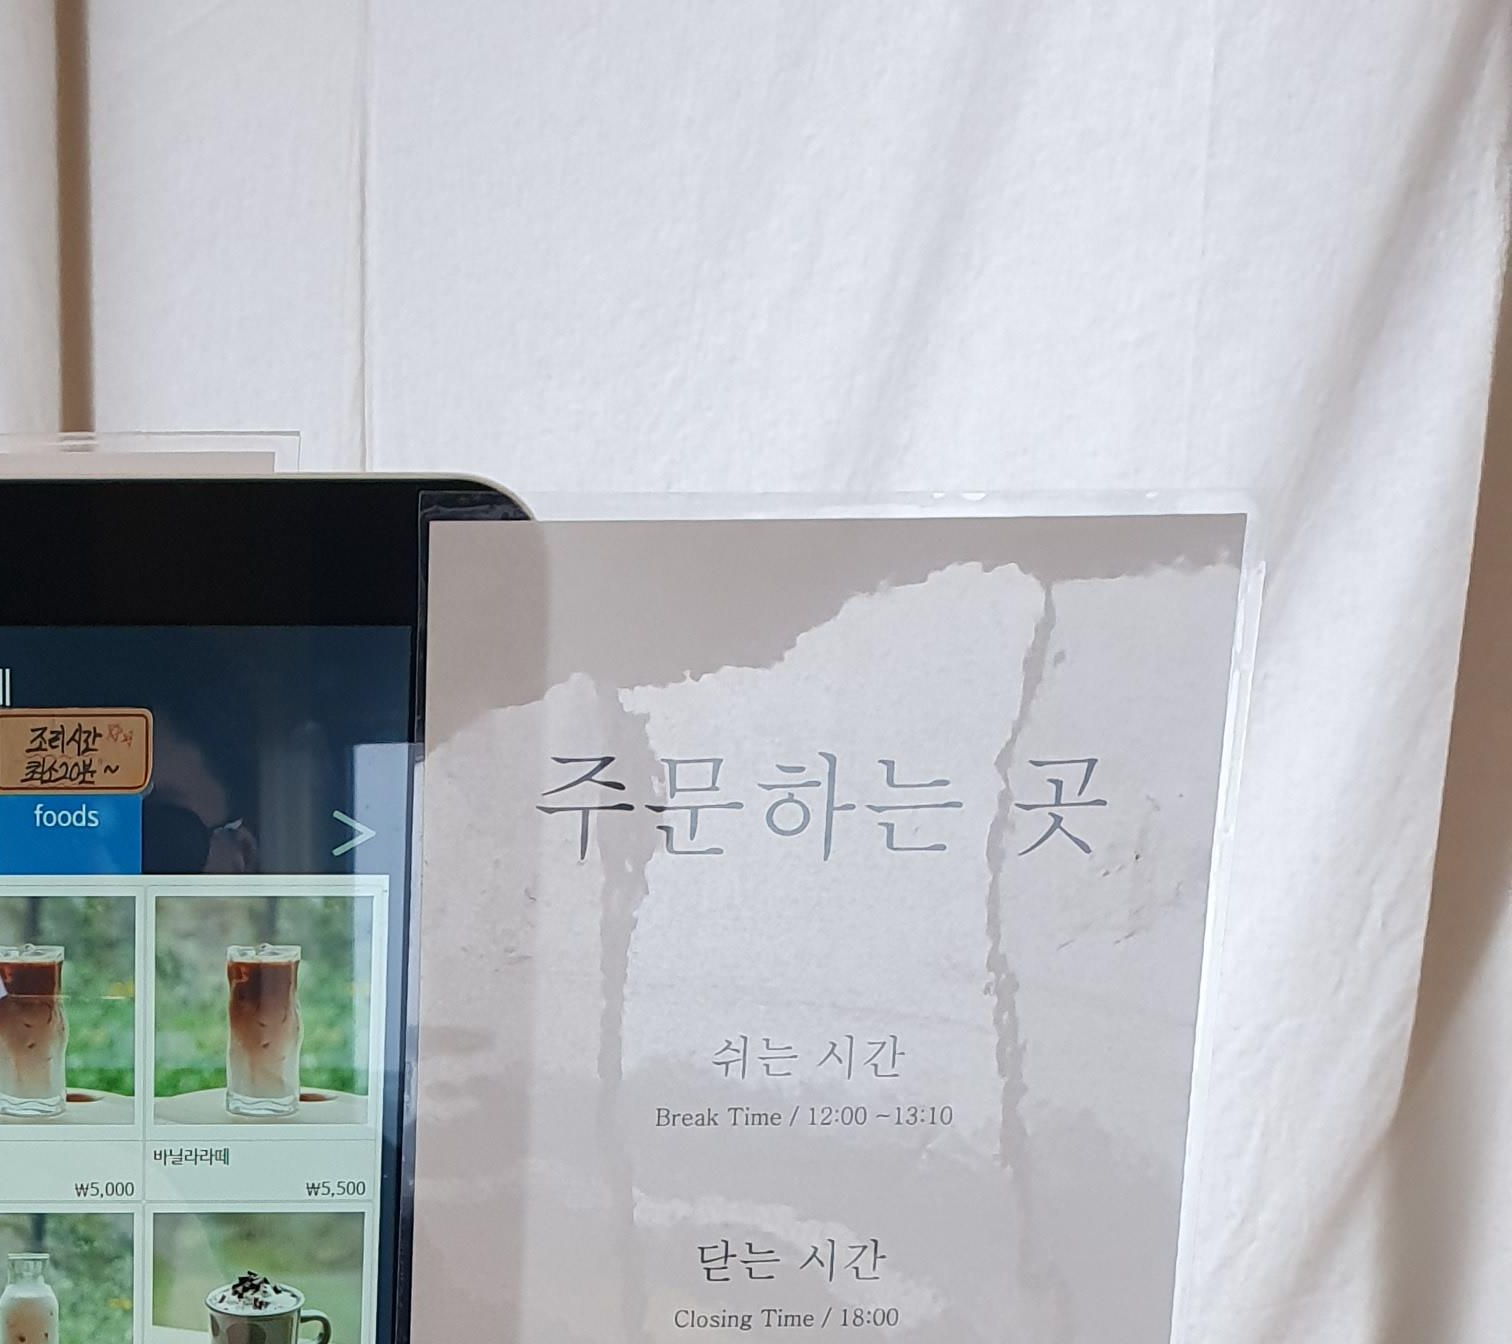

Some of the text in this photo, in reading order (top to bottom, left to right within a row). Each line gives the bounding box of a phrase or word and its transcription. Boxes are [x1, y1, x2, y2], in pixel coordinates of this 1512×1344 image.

[25, 723, 102, 756] 조리시간
[34, 804, 98, 826] foods
[536, 751, 1107, 862] 주문하는 곳
[712, 1035, 905, 1080] 쉬는 시간
[656, 1108, 718, 1126] Break
[728, 1107, 781, 1127] Time
[810, 1107, 867, 1125] 12:00
[154, 1148, 229, 1166] 바닐라라떼
[698, 1239, 886, 1282] 닫는 시간
[675, 1309, 752, 1330] Closing
[761, 1309, 814, 1328] Time
[841, 1308, 898, 1327] 18:00
